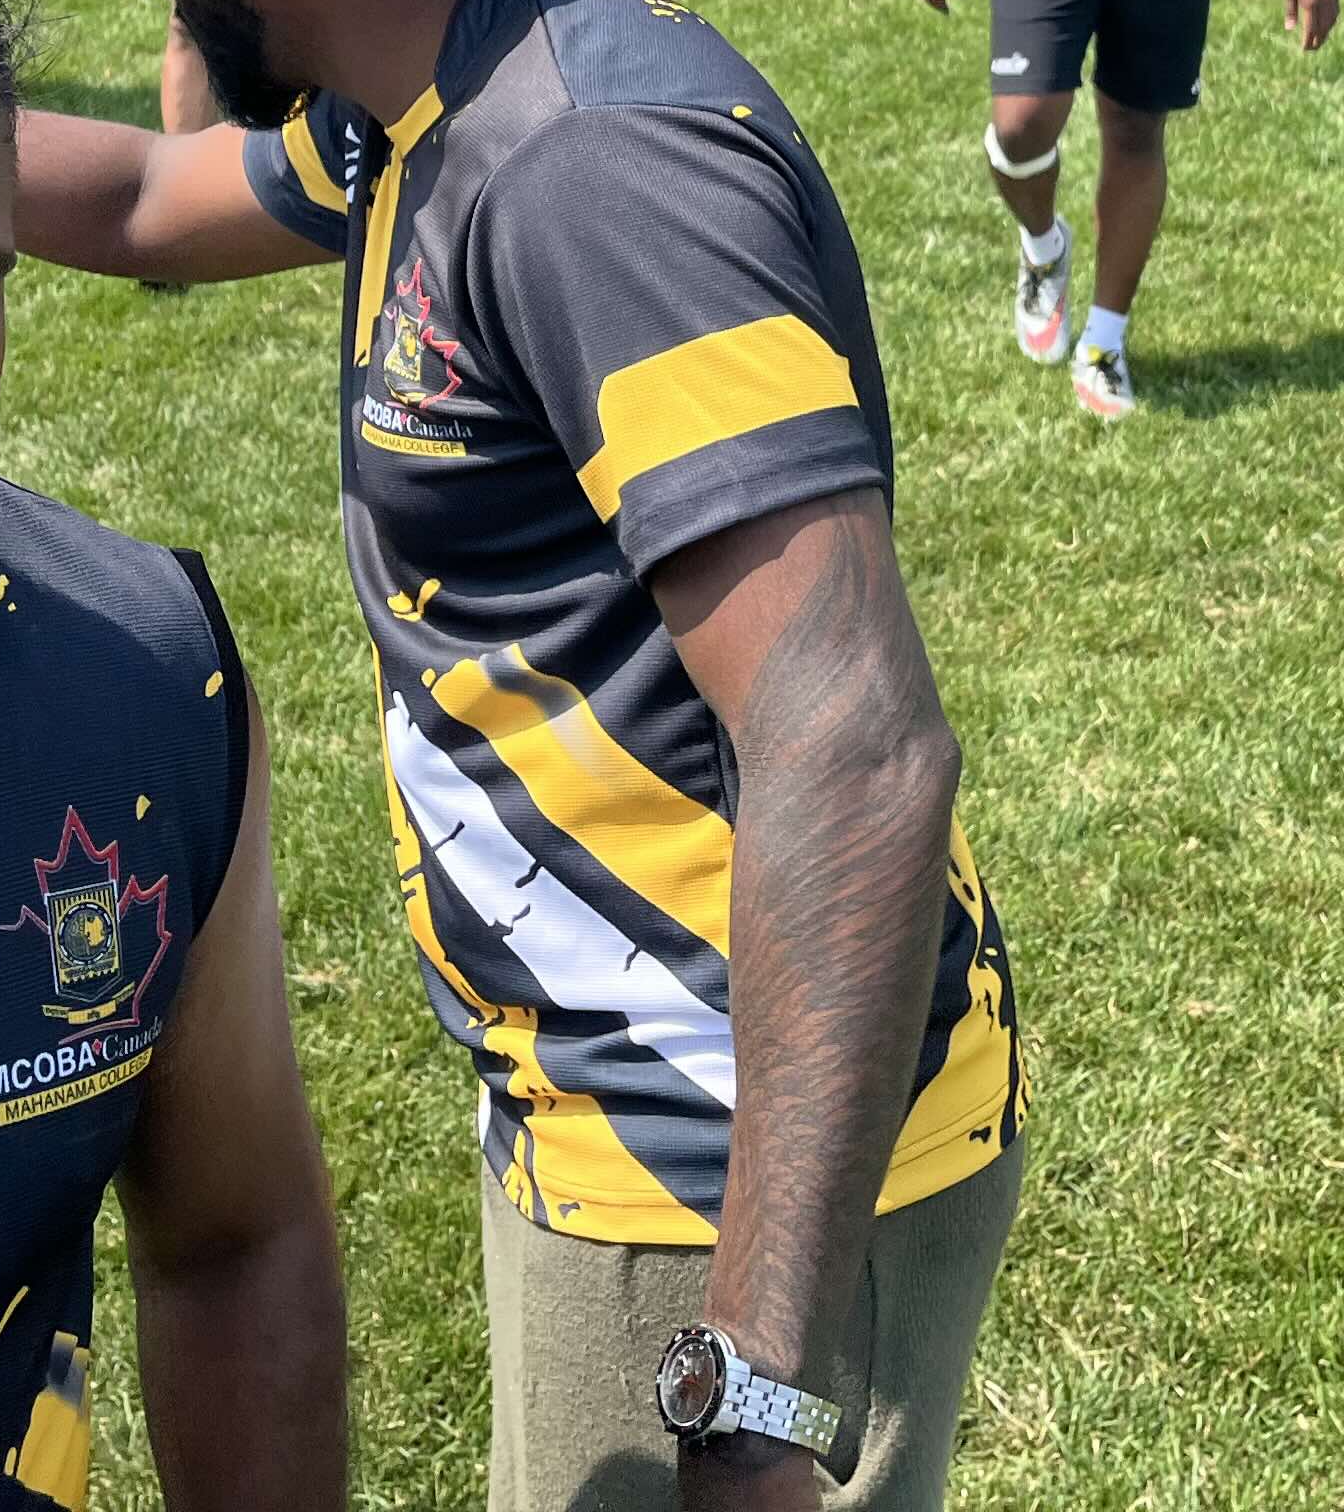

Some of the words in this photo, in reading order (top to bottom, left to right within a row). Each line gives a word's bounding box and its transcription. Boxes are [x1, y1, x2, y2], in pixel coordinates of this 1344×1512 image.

[406, 414, 473, 439] Canada
[403, 439, 459, 454] COLLEGE
[102, 1015, 163, 1062] Canada
[5, 1079, 97, 1122] MAHANAMA
[99, 1049, 151, 1091] COLLEGE
